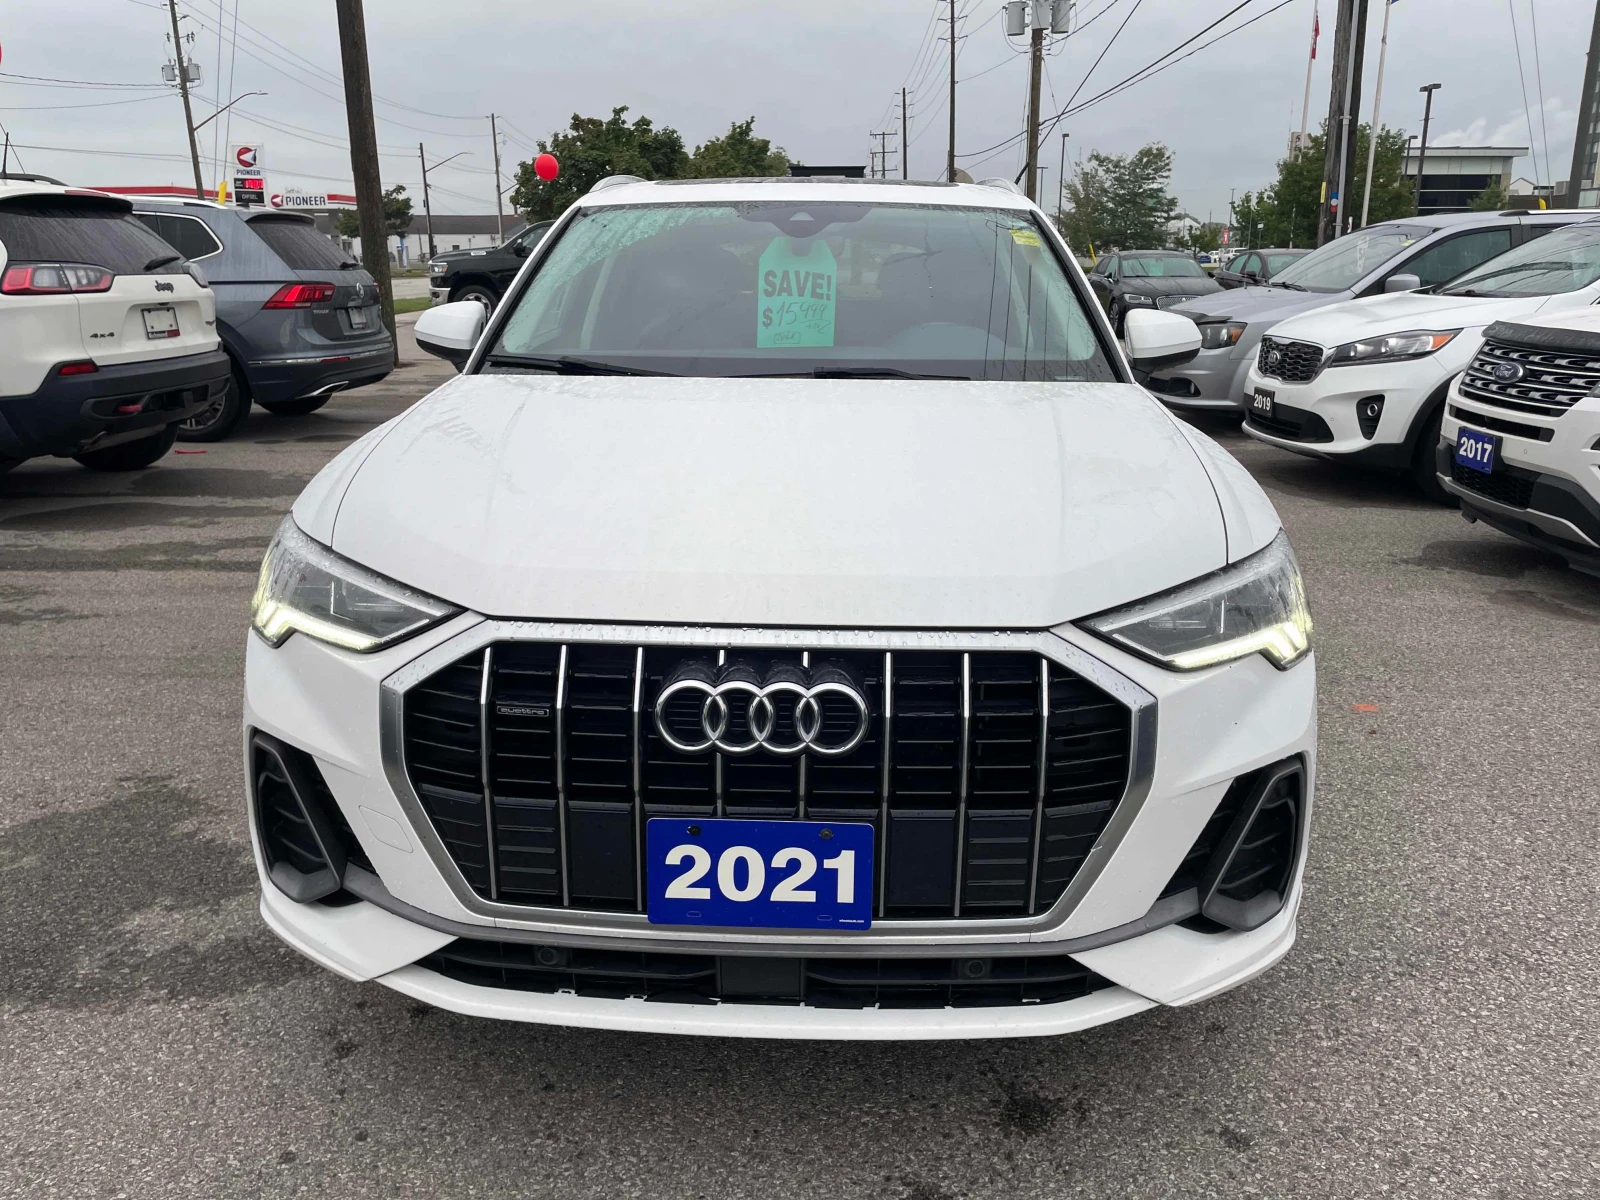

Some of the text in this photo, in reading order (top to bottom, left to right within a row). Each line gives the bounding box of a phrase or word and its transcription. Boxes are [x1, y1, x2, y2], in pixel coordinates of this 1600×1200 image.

[285, 196, 326, 206] PIONEER
[763, 270, 832, 301] SAVE!
[1253, 393, 1271, 411] 2019
[1459, 436, 1492, 463] 2017
[500, 707, 545, 715] quattro
[664, 844, 856, 904] 2021
